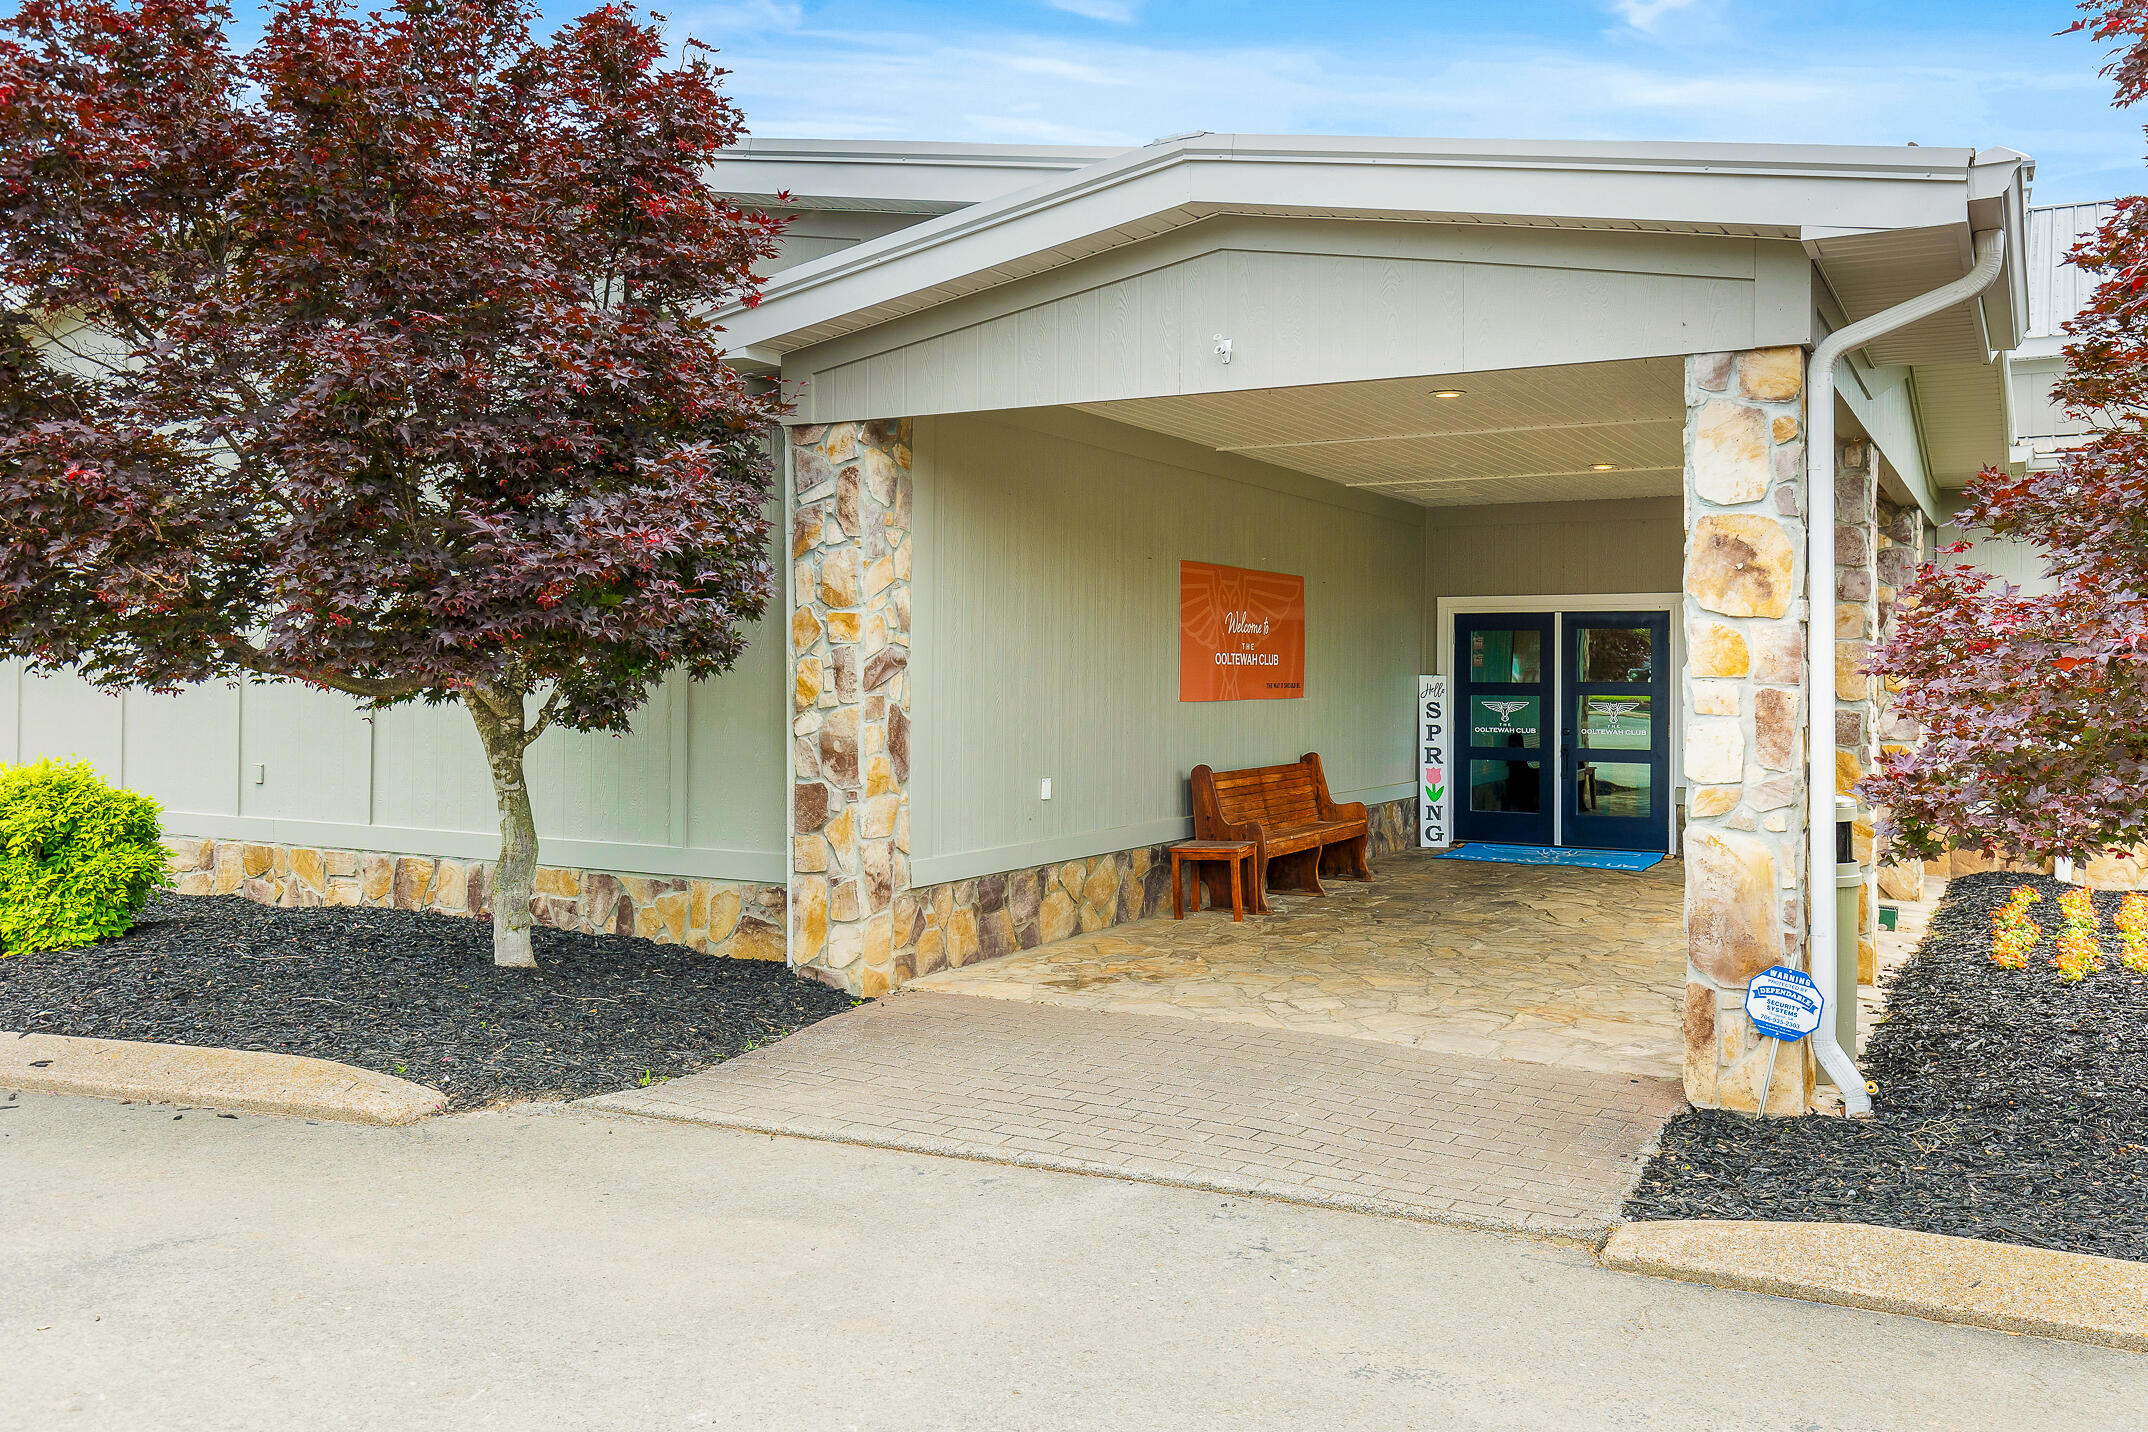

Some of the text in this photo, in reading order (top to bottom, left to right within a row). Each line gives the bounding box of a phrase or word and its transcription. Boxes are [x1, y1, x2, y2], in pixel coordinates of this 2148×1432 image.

[1225, 611, 1269, 635] Welcome to
[1215, 653, 1279, 666] OOLTEWAH CLUB
[1420, 682, 1445, 699] Hello
[1474, 726, 1515, 734] OOLTEWAH
[1767, 978, 1800, 990] PROTECTED
[1770, 969, 1811, 986] WARNING
[1759, 987, 1812, 1006] DEPENDABLE
[1766, 998, 1801, 1011] SECURITY
[1766, 1004, 1798, 1018] SYSTEMS
